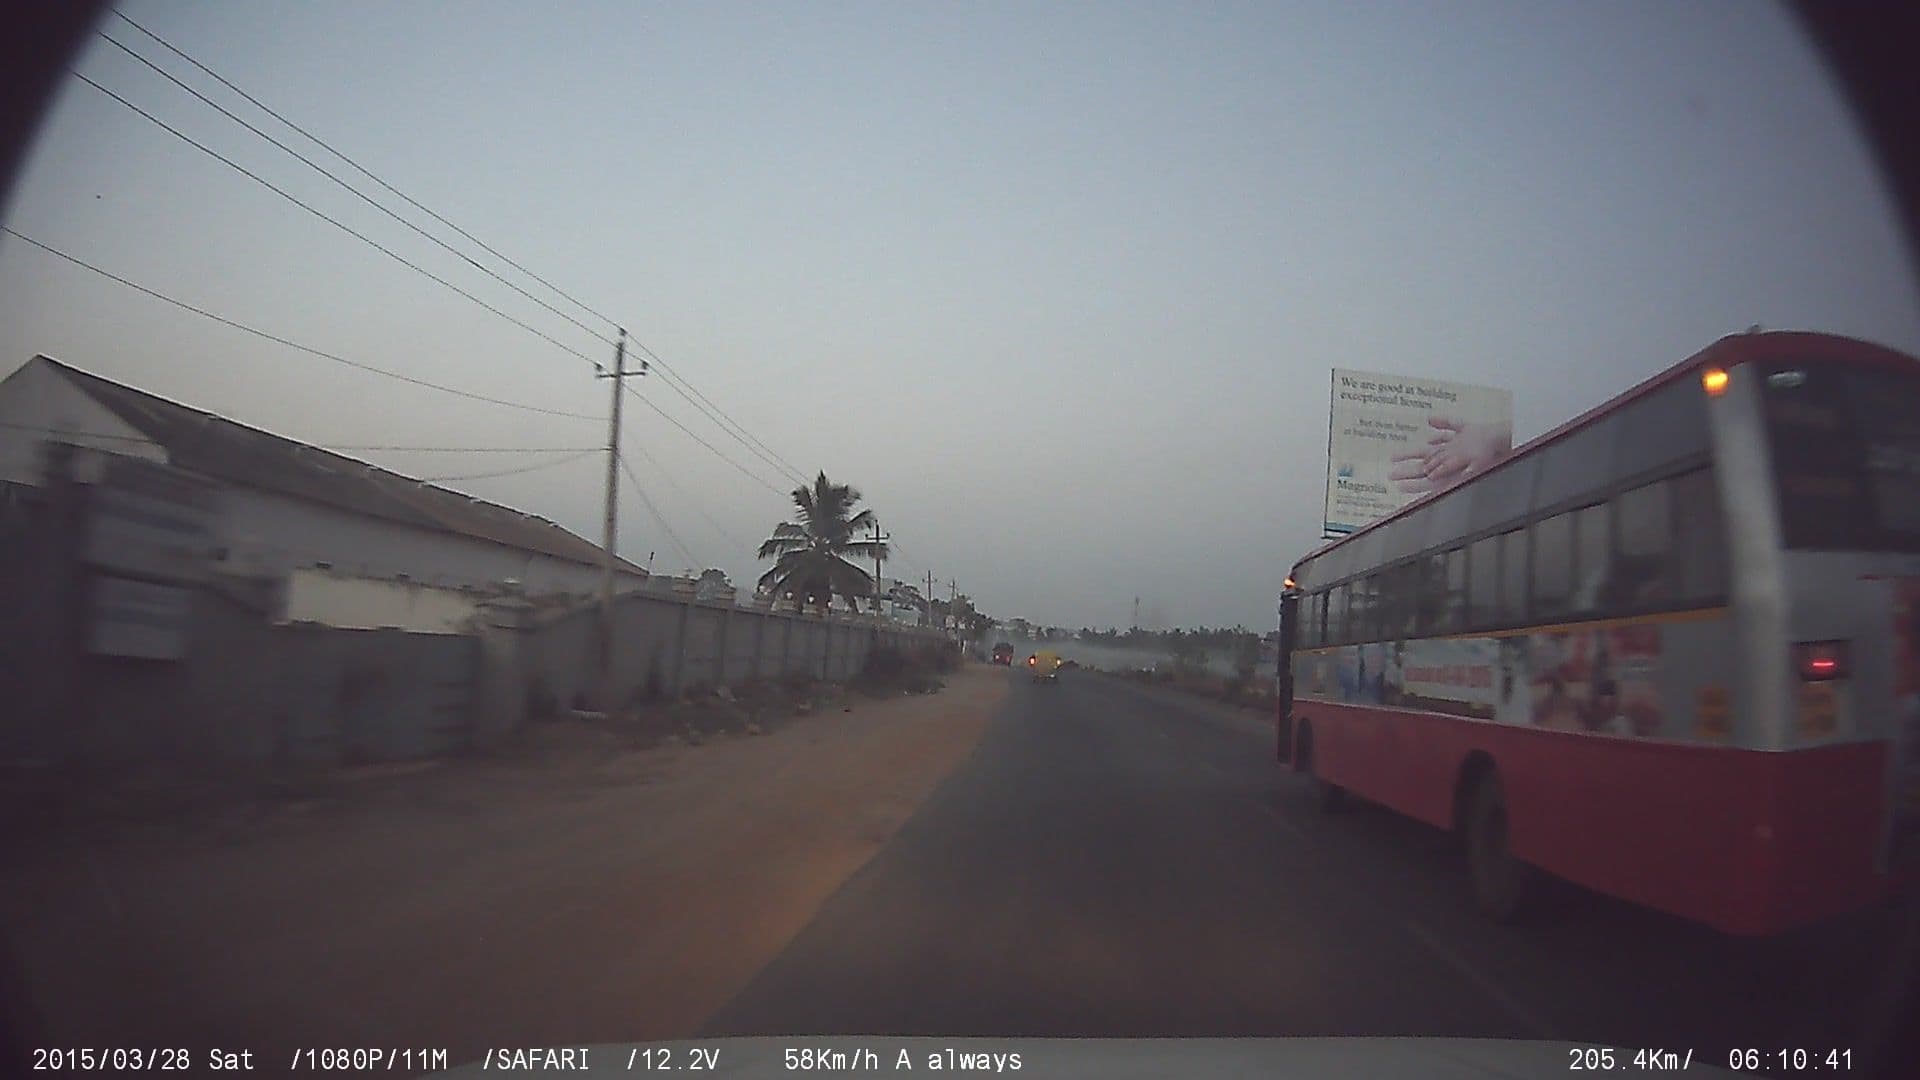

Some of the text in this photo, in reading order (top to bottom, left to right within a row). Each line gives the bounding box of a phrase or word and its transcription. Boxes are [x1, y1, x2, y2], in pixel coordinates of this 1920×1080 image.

[1340, 376, 1457, 403] We are good at building
[1340, 392, 1432, 409] exceptional homes
[1337, 479, 1387, 494] Magnolia
